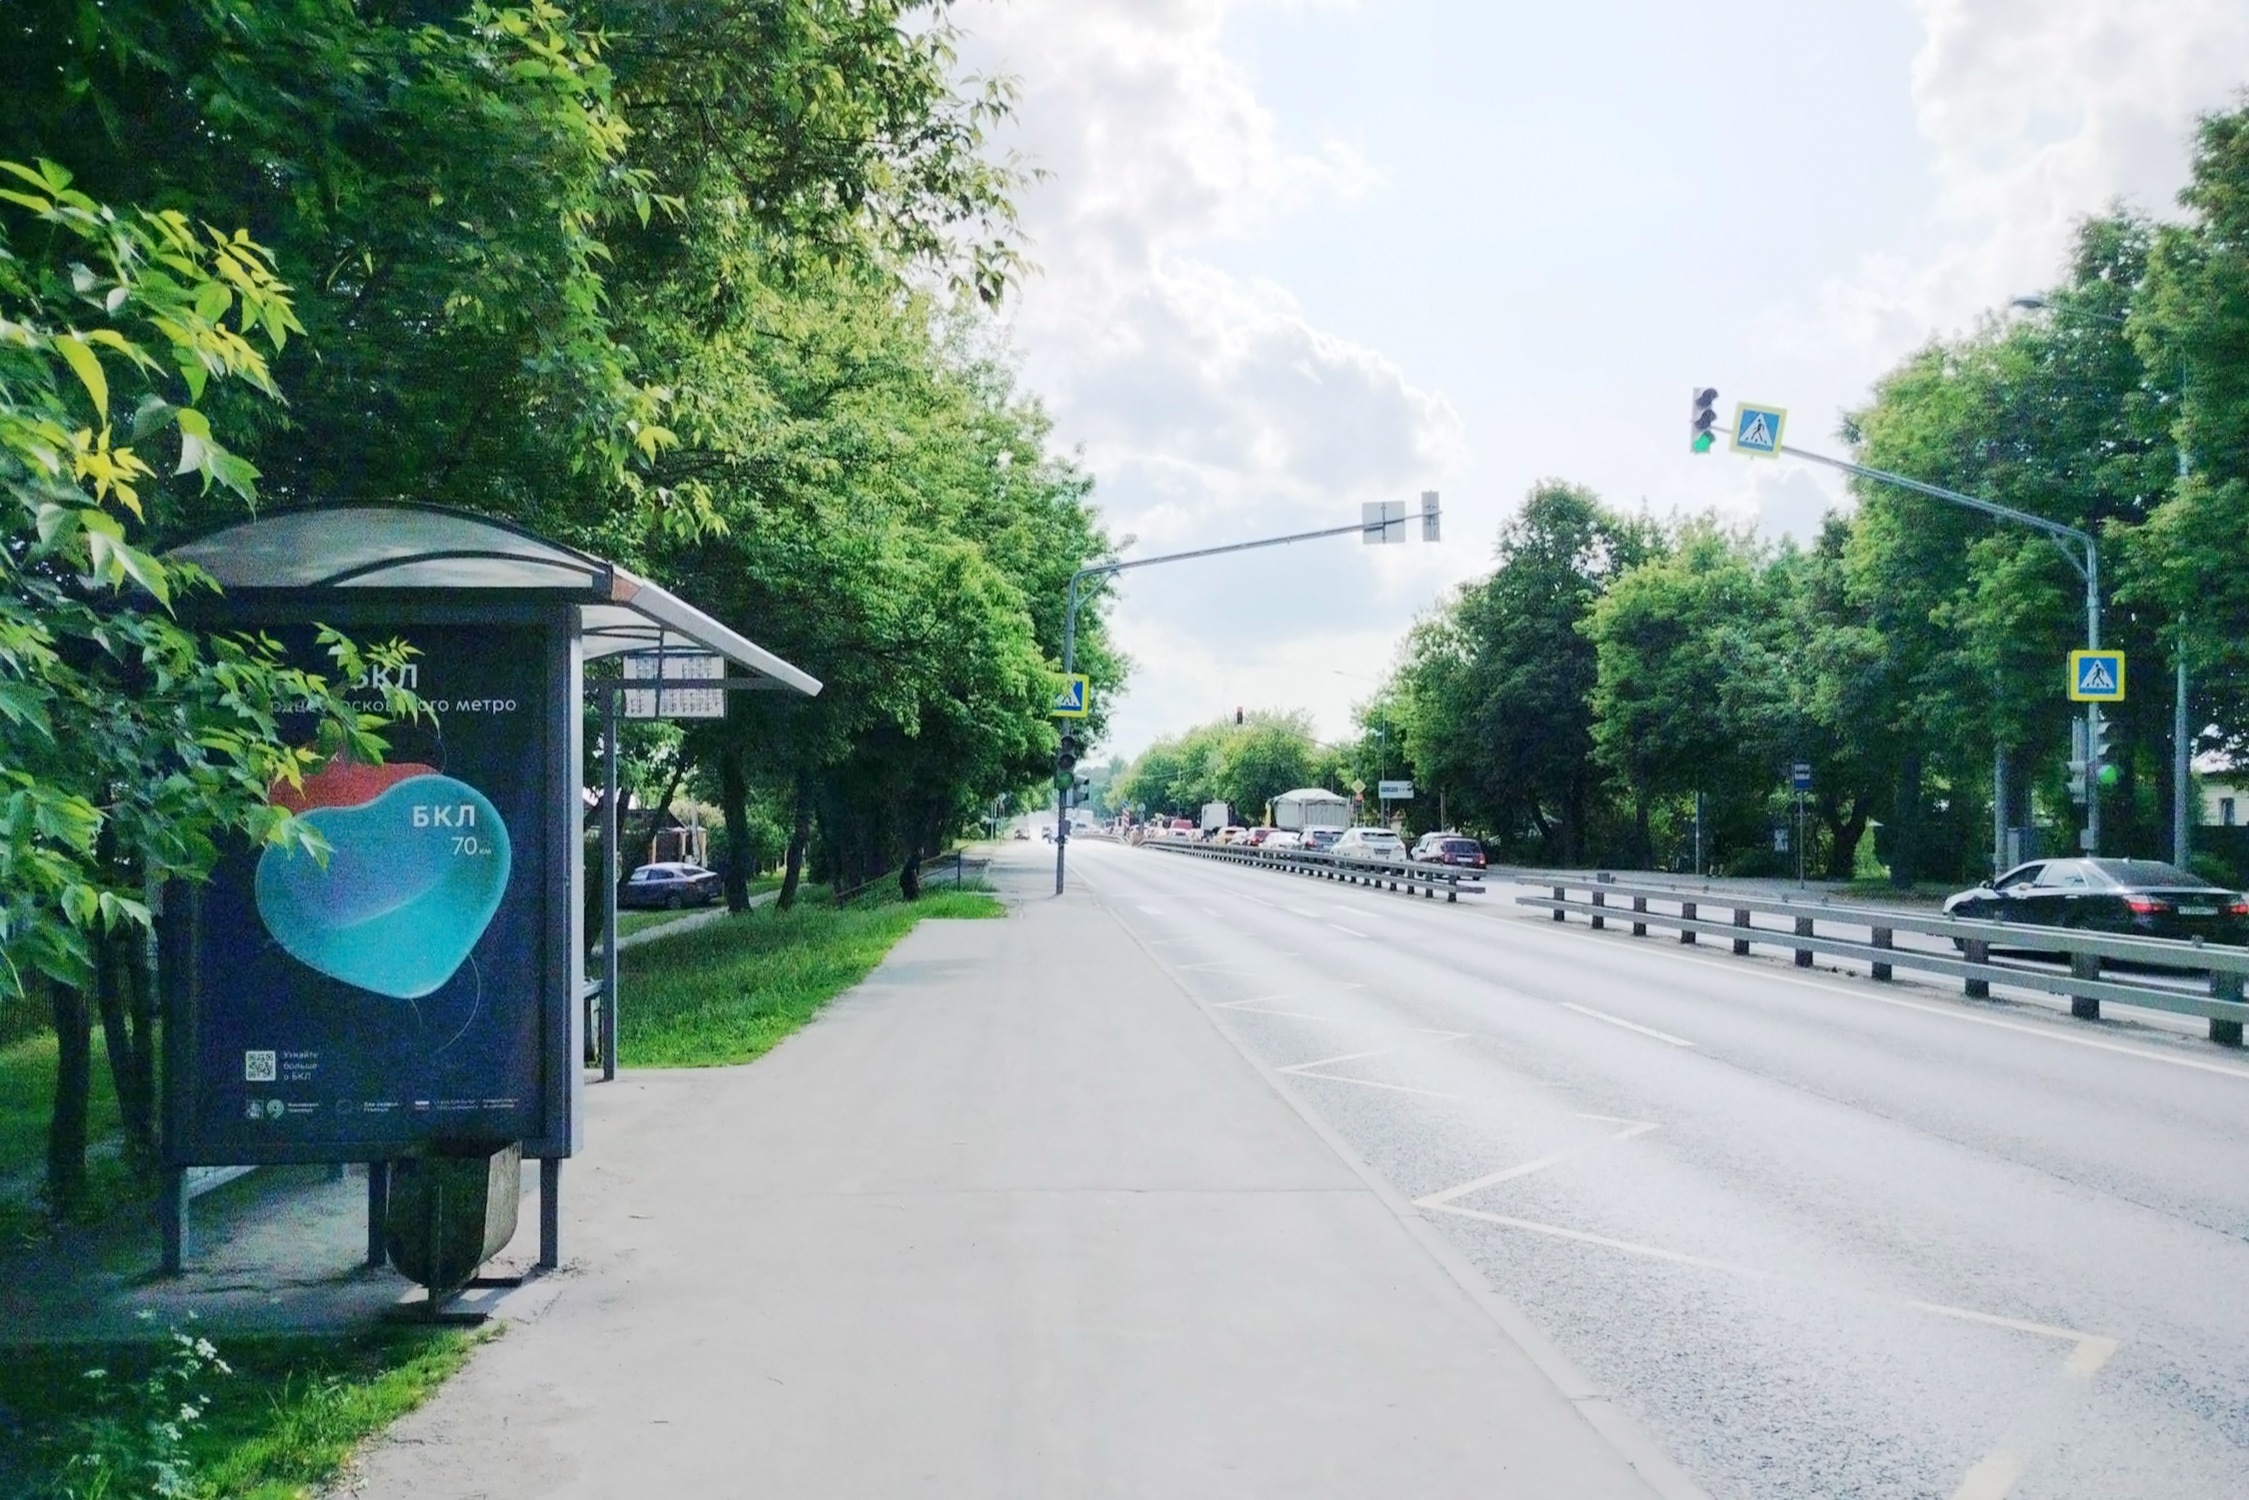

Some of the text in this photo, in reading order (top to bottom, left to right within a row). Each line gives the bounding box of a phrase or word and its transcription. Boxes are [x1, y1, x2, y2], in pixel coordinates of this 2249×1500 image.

[455, 699, 517, 714] метро
[412, 804, 475, 828] БКЛ
[451, 836, 477, 856] 70
